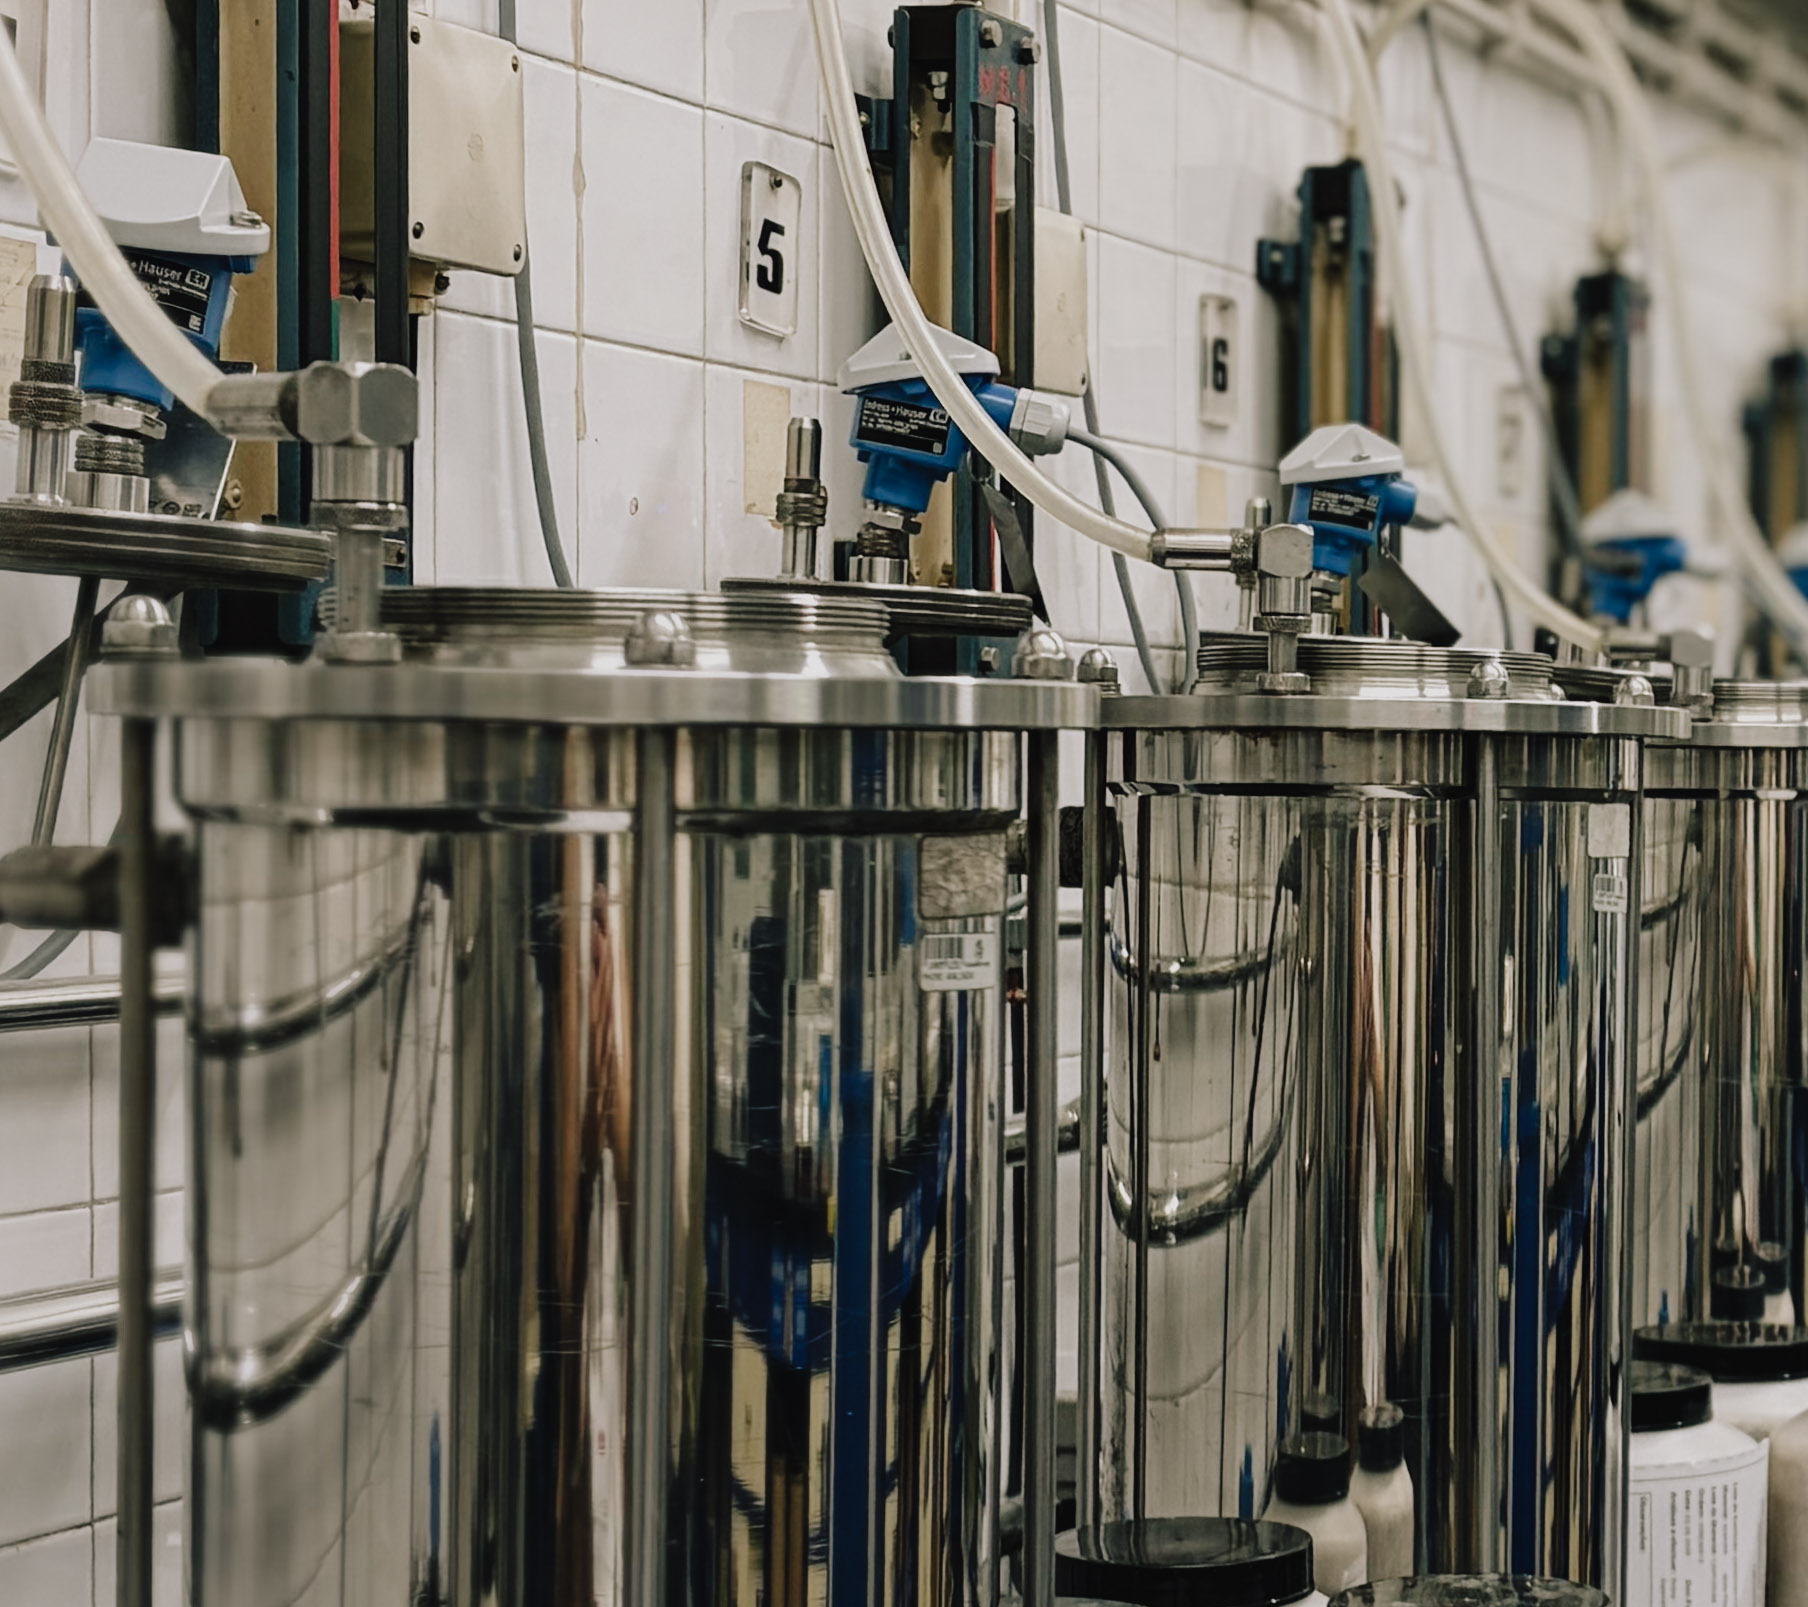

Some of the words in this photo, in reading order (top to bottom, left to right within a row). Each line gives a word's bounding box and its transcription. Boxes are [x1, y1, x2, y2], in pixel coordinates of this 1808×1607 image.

[139, 260, 183, 281] Hauser
[756, 217, 786, 294] 5
[1211, 337, 1229, 393] 6
